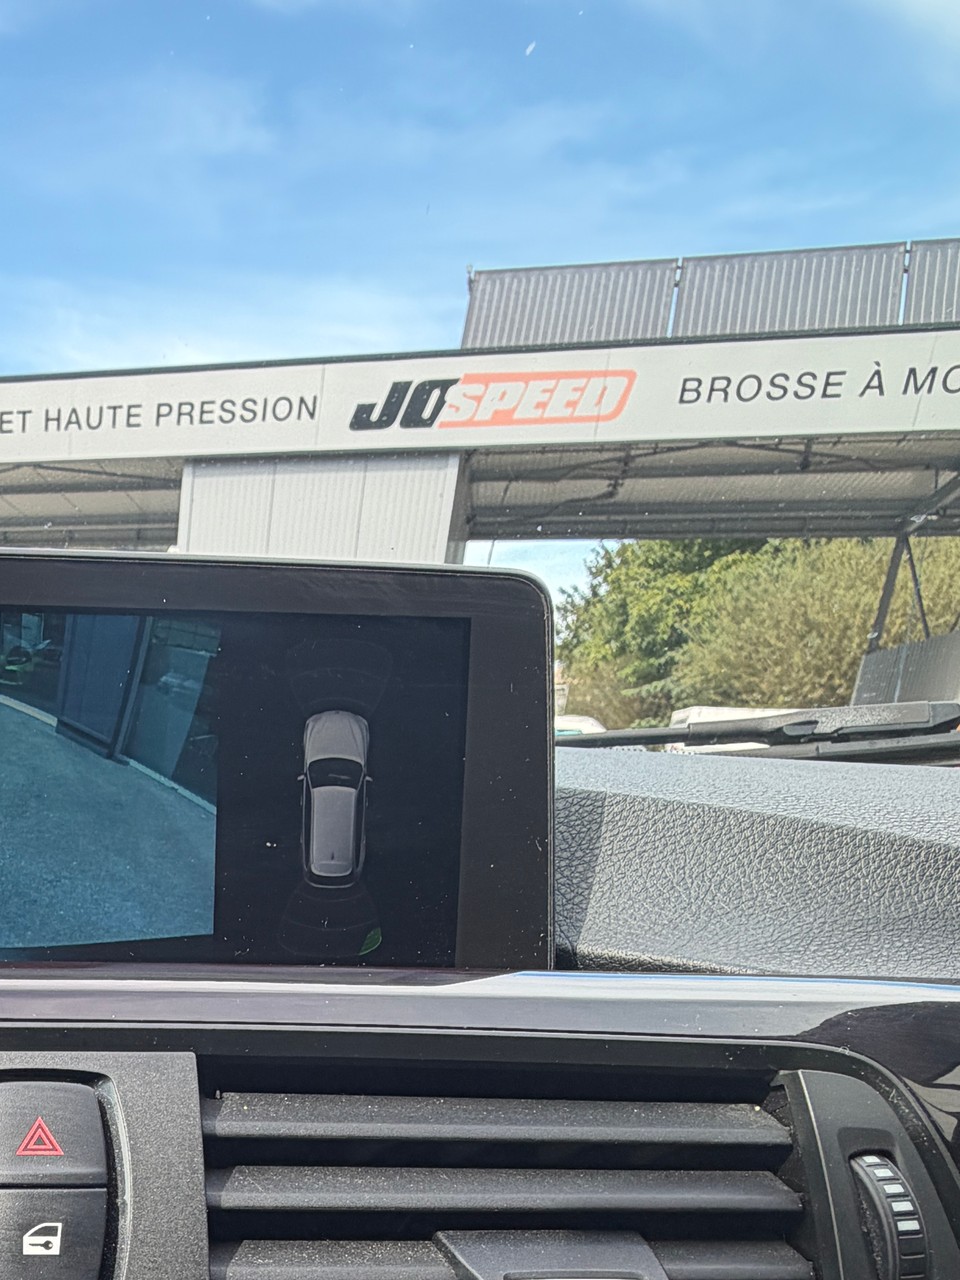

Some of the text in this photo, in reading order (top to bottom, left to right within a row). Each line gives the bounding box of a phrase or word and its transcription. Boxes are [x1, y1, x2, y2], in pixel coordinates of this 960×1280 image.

[349, 369, 637, 431] JOSPEED
[678, 370, 846, 404] BROSSE
[858, 361, 885, 397] À
[43, 404, 142, 432] HAUTE
[155, 394, 318, 427] PRESSION
